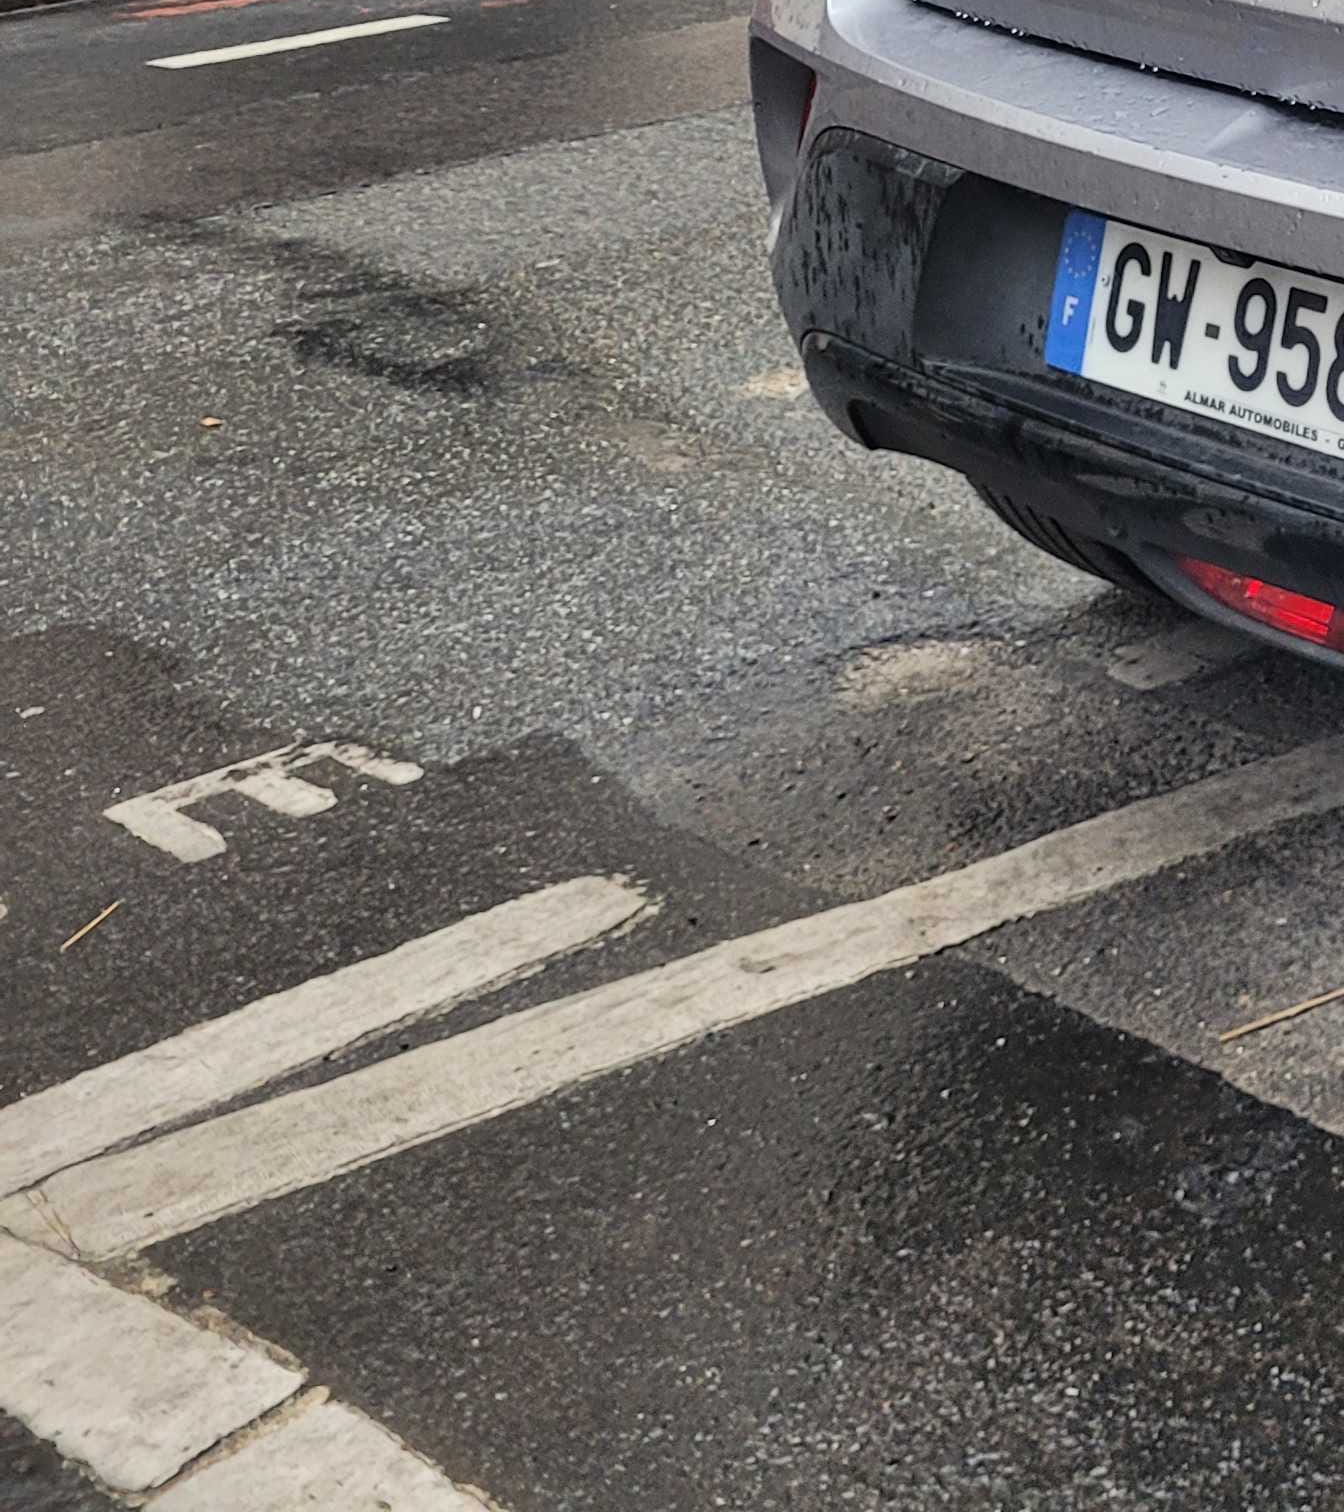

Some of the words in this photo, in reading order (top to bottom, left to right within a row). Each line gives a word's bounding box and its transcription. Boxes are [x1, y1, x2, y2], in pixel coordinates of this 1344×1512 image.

[1061, 294, 1080, 327] F
[1183, 389, 1228, 416] ALMAR
[1228, 401, 1320, 444] AUTOMOBILES
